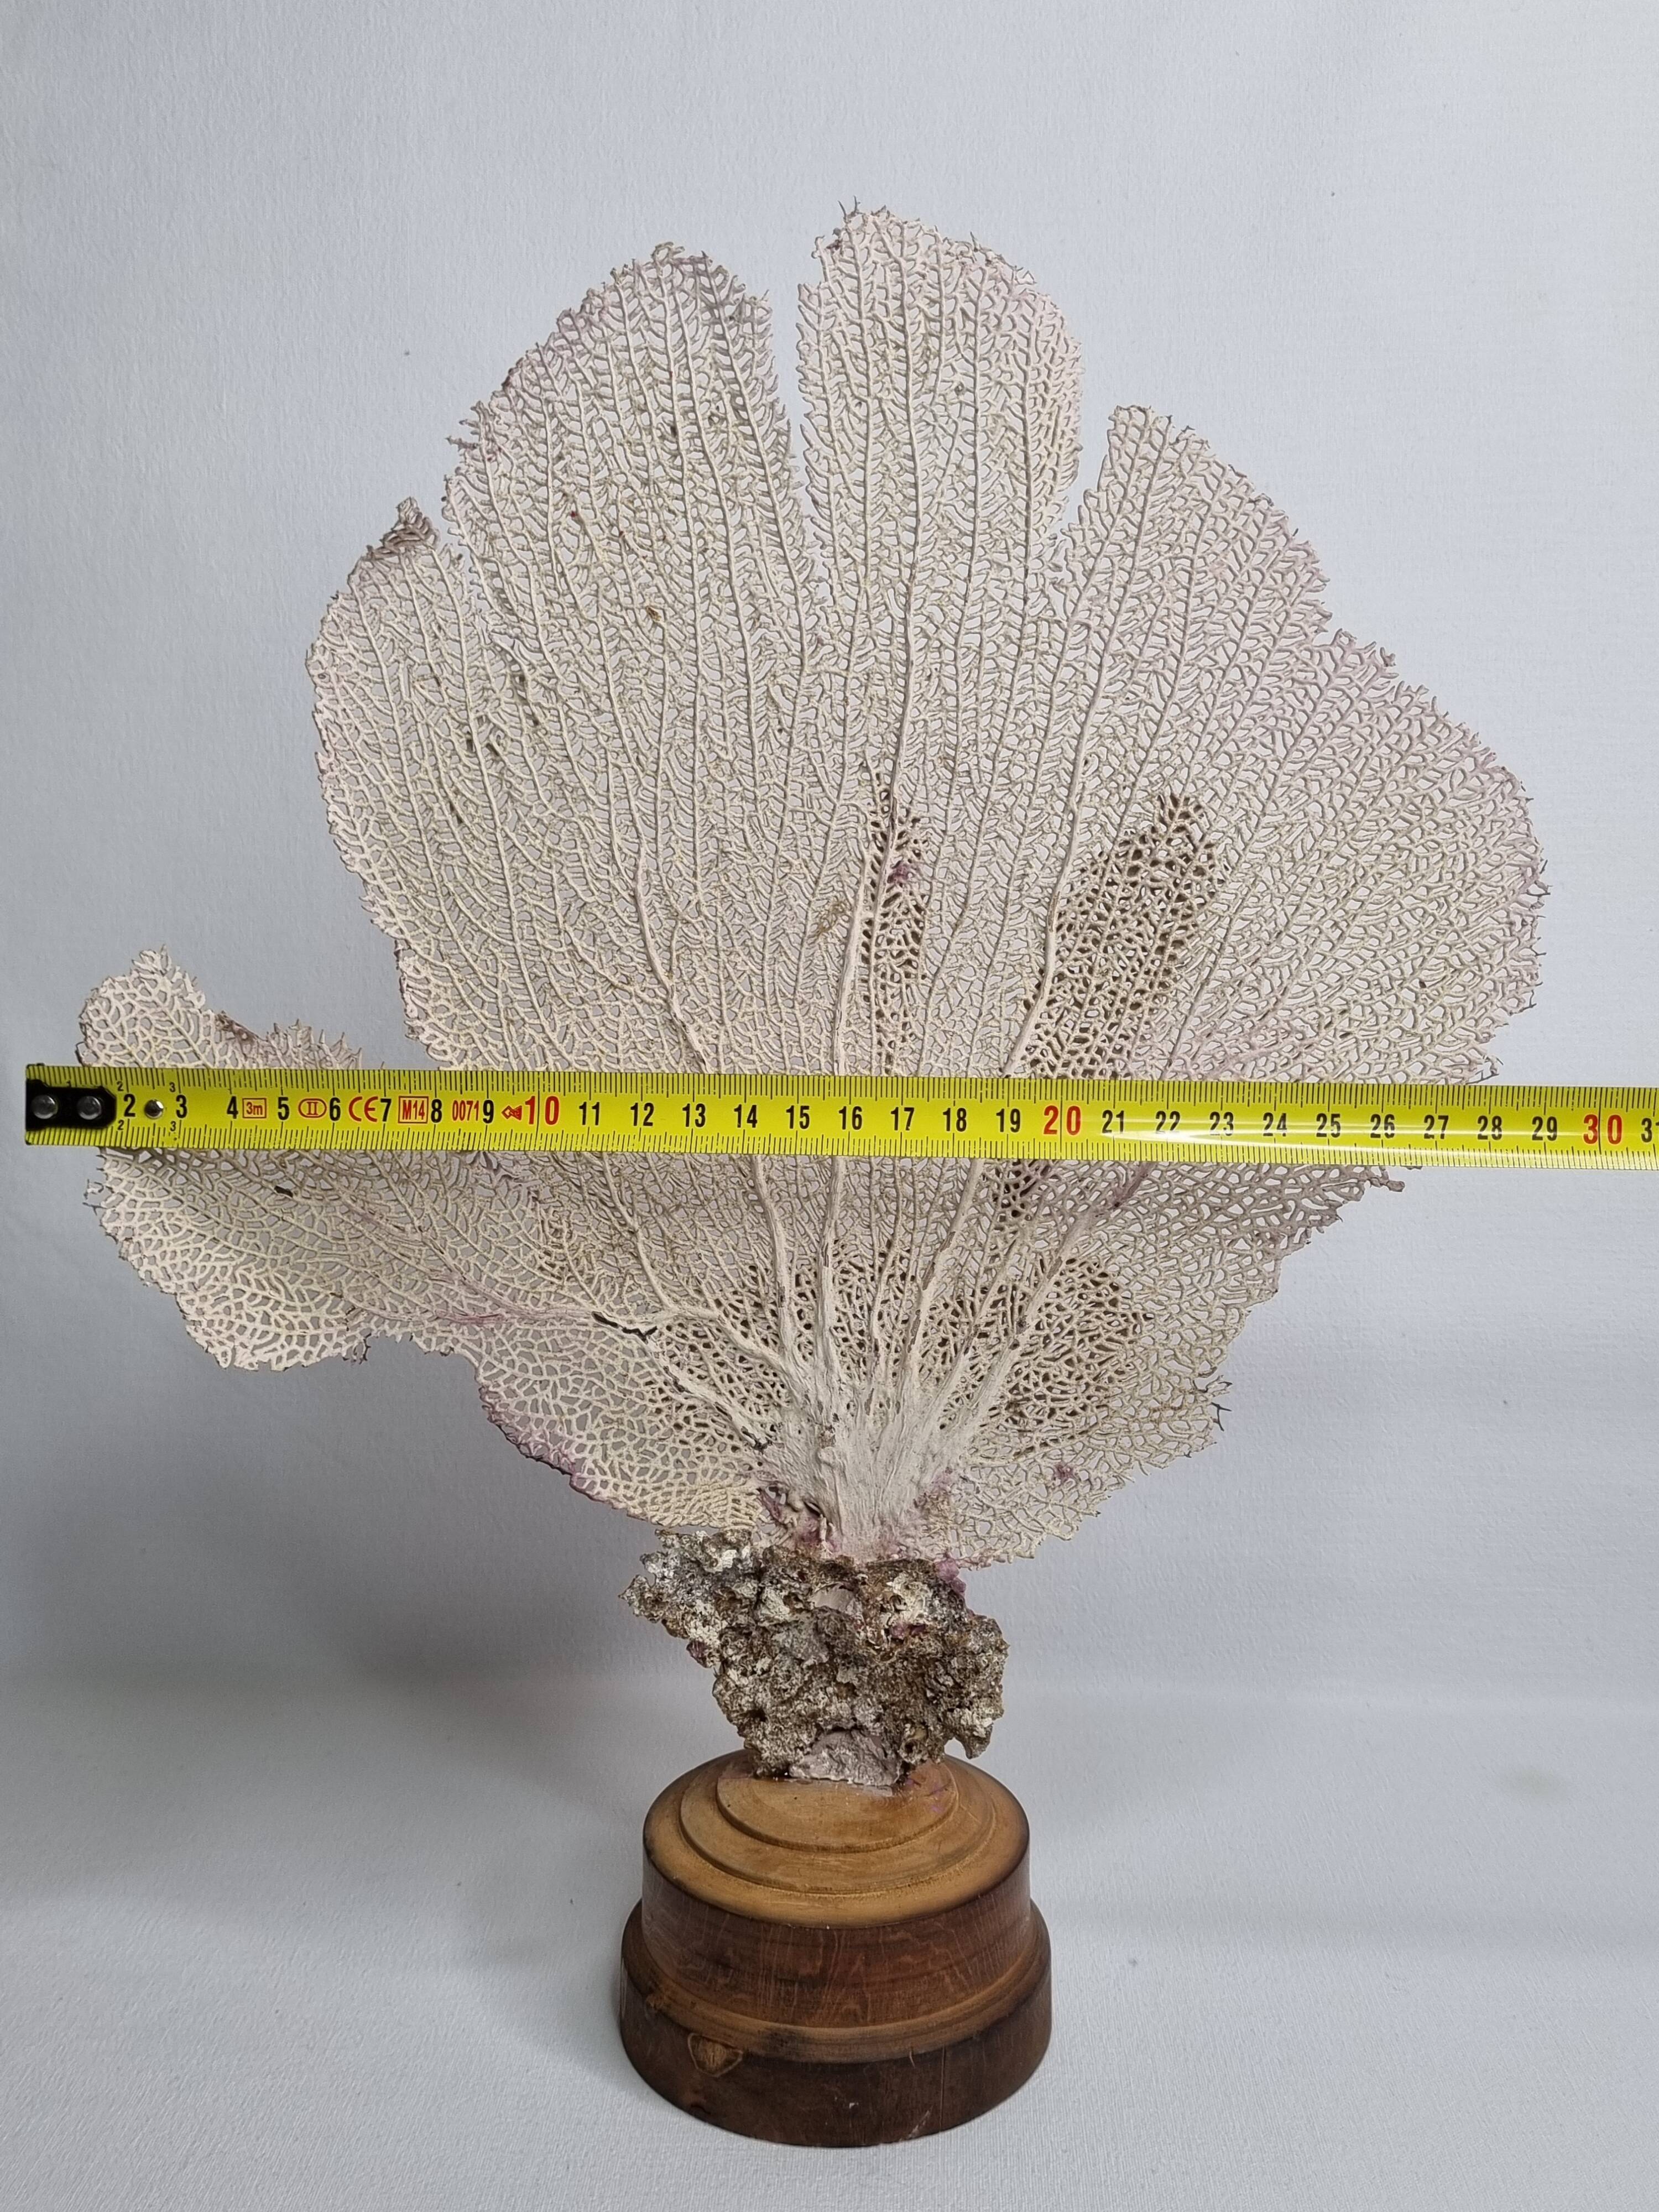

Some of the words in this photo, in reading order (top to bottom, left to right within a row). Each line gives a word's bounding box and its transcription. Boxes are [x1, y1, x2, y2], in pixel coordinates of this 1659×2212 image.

[117, 1081, 124, 1092] 2
[169, 1082, 176, 1092] 3
[123, 1093, 135, 1117] 2
[176, 1094, 187, 1118] 3
[227, 1096, 238, 1119] 4
[246, 1102, 263, 1115] 3m
[278, 1097, 290, 1120] 5
[329, 1097, 341, 1121] 6
[348, 1096, 378, 1122] CE
[380, 1098, 392, 1122] 7
[402, 1100, 426, 1120] M14
[431, 1099, 442, 1123] 8
[452, 1100, 479, 1121] 0071
[483, 1099, 494, 1124] 9
[525, 1095, 559, 1125] 10
[579, 1101, 601, 1126] 11
[630, 1102, 654, 1126] 12
[682, 1103, 706, 1128] 13
[734, 1103, 758, 1128] 14
[786, 1105, 810, 1129] 15
[838, 1105, 863, 1130] 16
[890, 1107, 915, 1131] 17
[942, 1107, 967, 1132] 18
[996, 1108, 1021, 1133] 19
[1043, 1105, 1082, 1136] 20
[1102, 1109, 1125, 1134] 21
[1155, 1110, 1180, 1135] 22
[1209, 1111, 1234, 1136] 23
[1262, 1112, 1287, 1137] 24
[1316, 1113, 1341, 1138] 25
[1370, 1113, 1395, 1139] 26
[1423, 1114, 1449, 1139] 27
[1477, 1115, 1503, 1140] 28
[1531, 1116, 1558, 1141] 29
[1583, 1114, 1623, 1145] 30
[1641, 1118, 1659, 1143] 3
[118, 1120, 124, 1131] 2
[170, 1121, 176, 1131] 3
